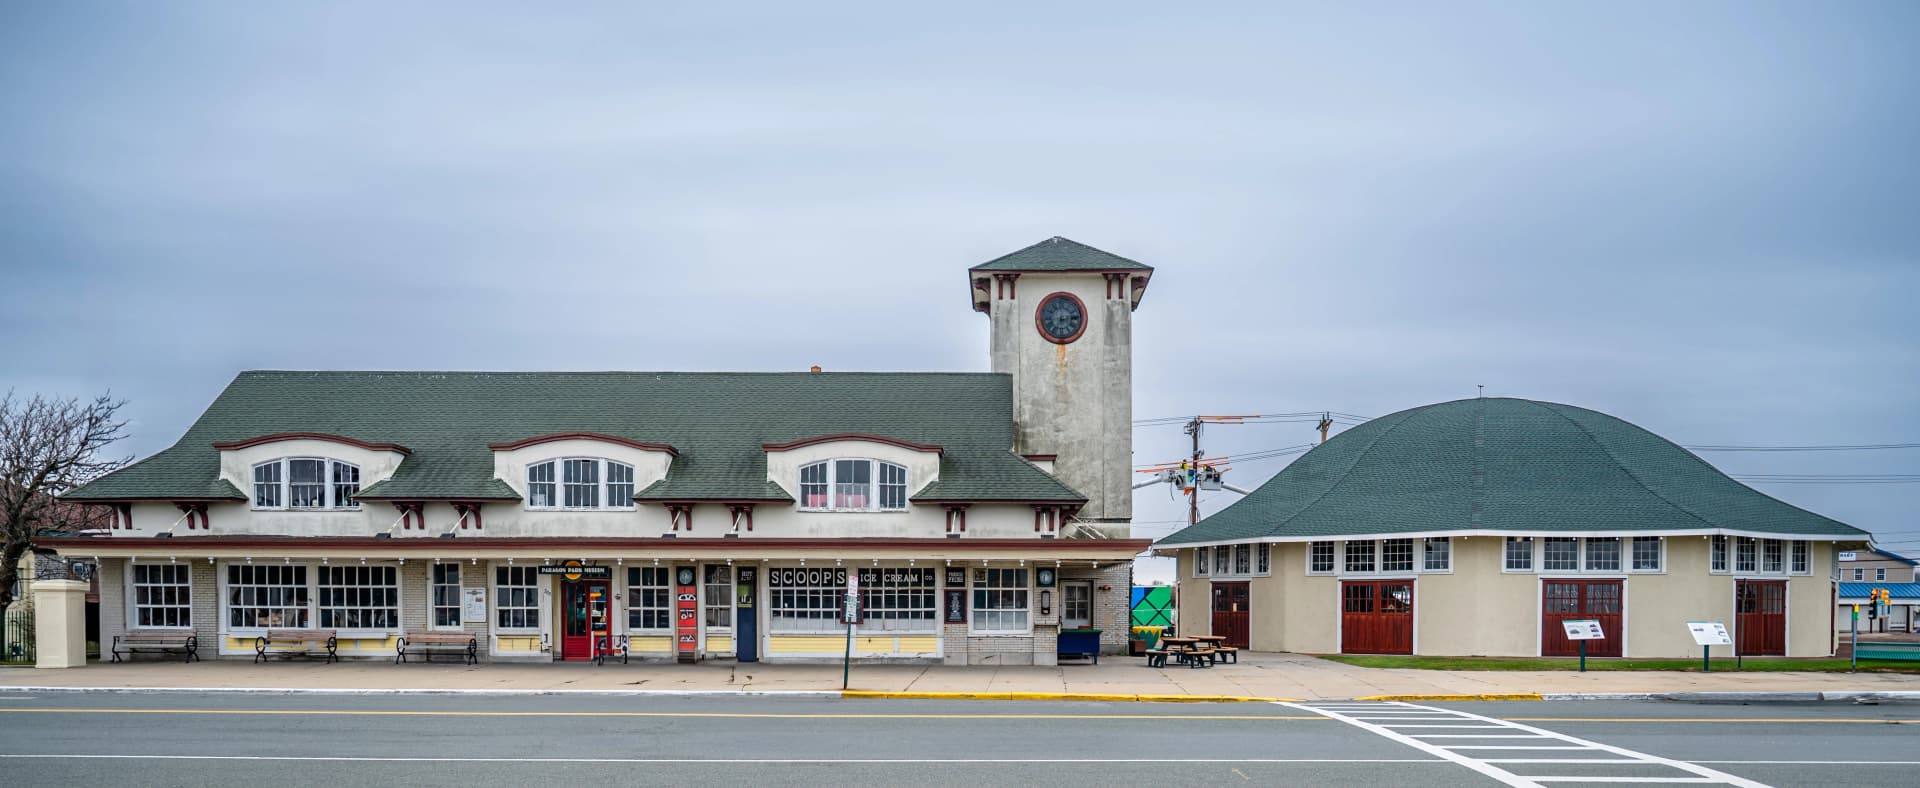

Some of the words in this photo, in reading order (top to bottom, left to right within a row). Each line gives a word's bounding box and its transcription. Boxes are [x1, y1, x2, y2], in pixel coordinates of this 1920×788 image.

[771, 571, 846, 584] SCOOPS
[860, 573, 877, 583] ICE
[884, 573, 918, 583] CREAM
